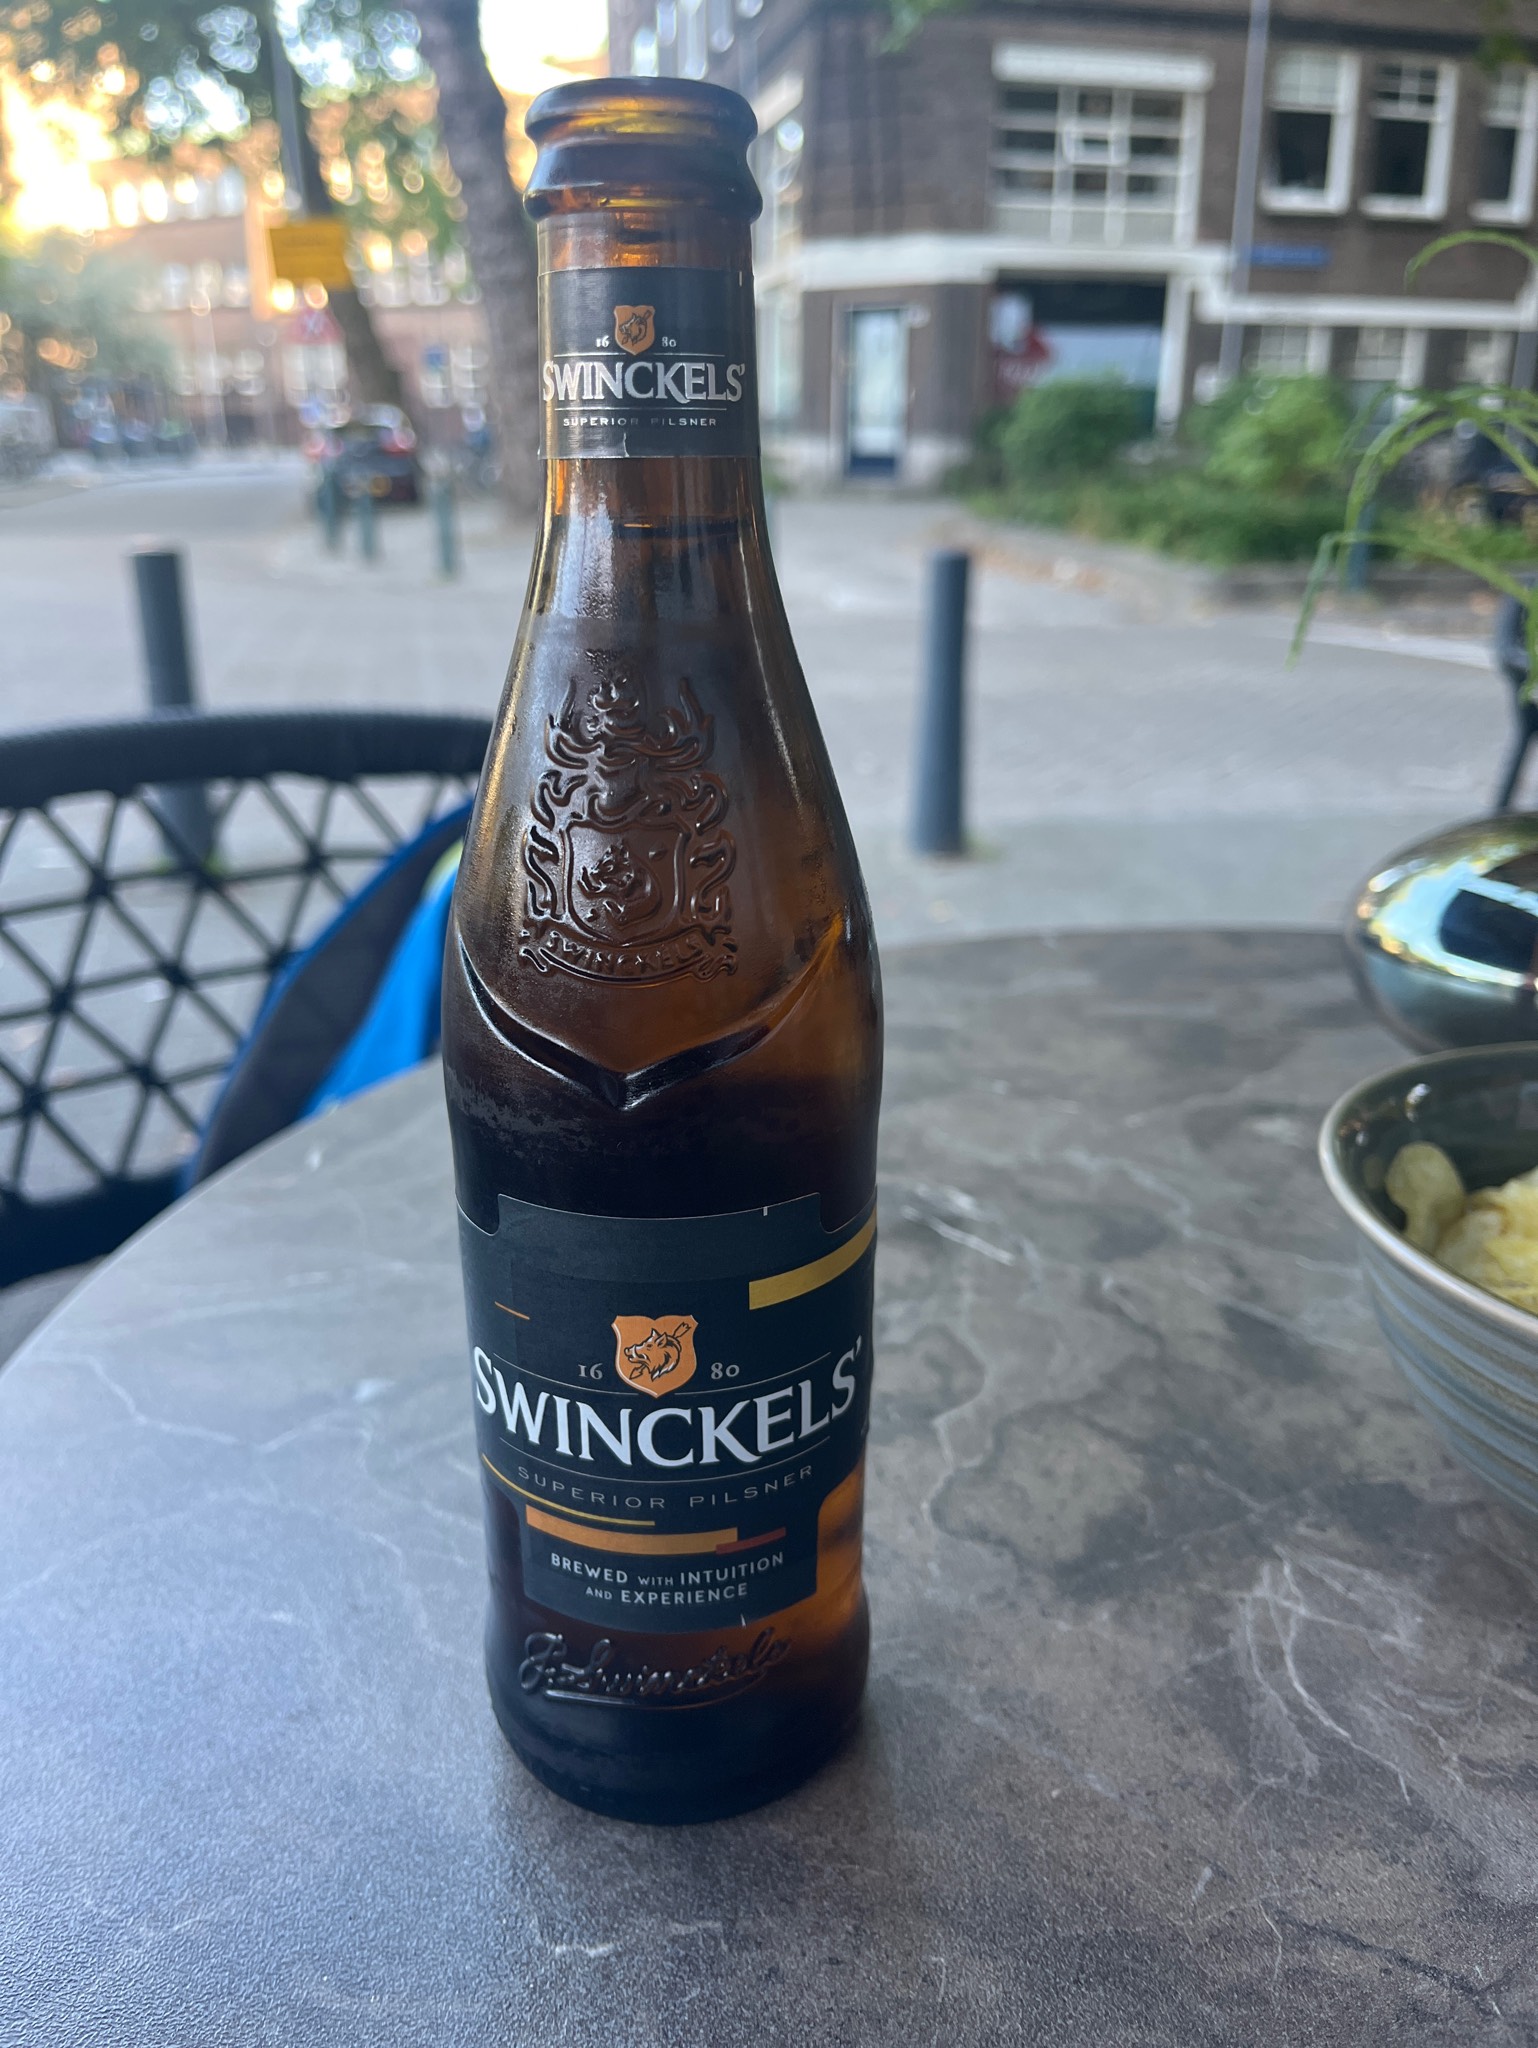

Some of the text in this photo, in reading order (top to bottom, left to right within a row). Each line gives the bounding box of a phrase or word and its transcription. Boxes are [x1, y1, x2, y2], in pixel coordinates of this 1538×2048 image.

[661, 336, 677, 348] 80
[543, 361, 745, 404] SWINCKELS'
[563, 417, 717, 427] SUPERIOR PILSNER
[578, 1362, 740, 1380] 16 80
[473, 1335, 862, 1467] SWINCKELS'
[518, 1465, 812, 1509] SUPERIOR PILSNER
[551, 1551, 784, 1586] BREWED WITH INTUITION
[585, 1582, 748, 1605] AND EXPERIENCE
